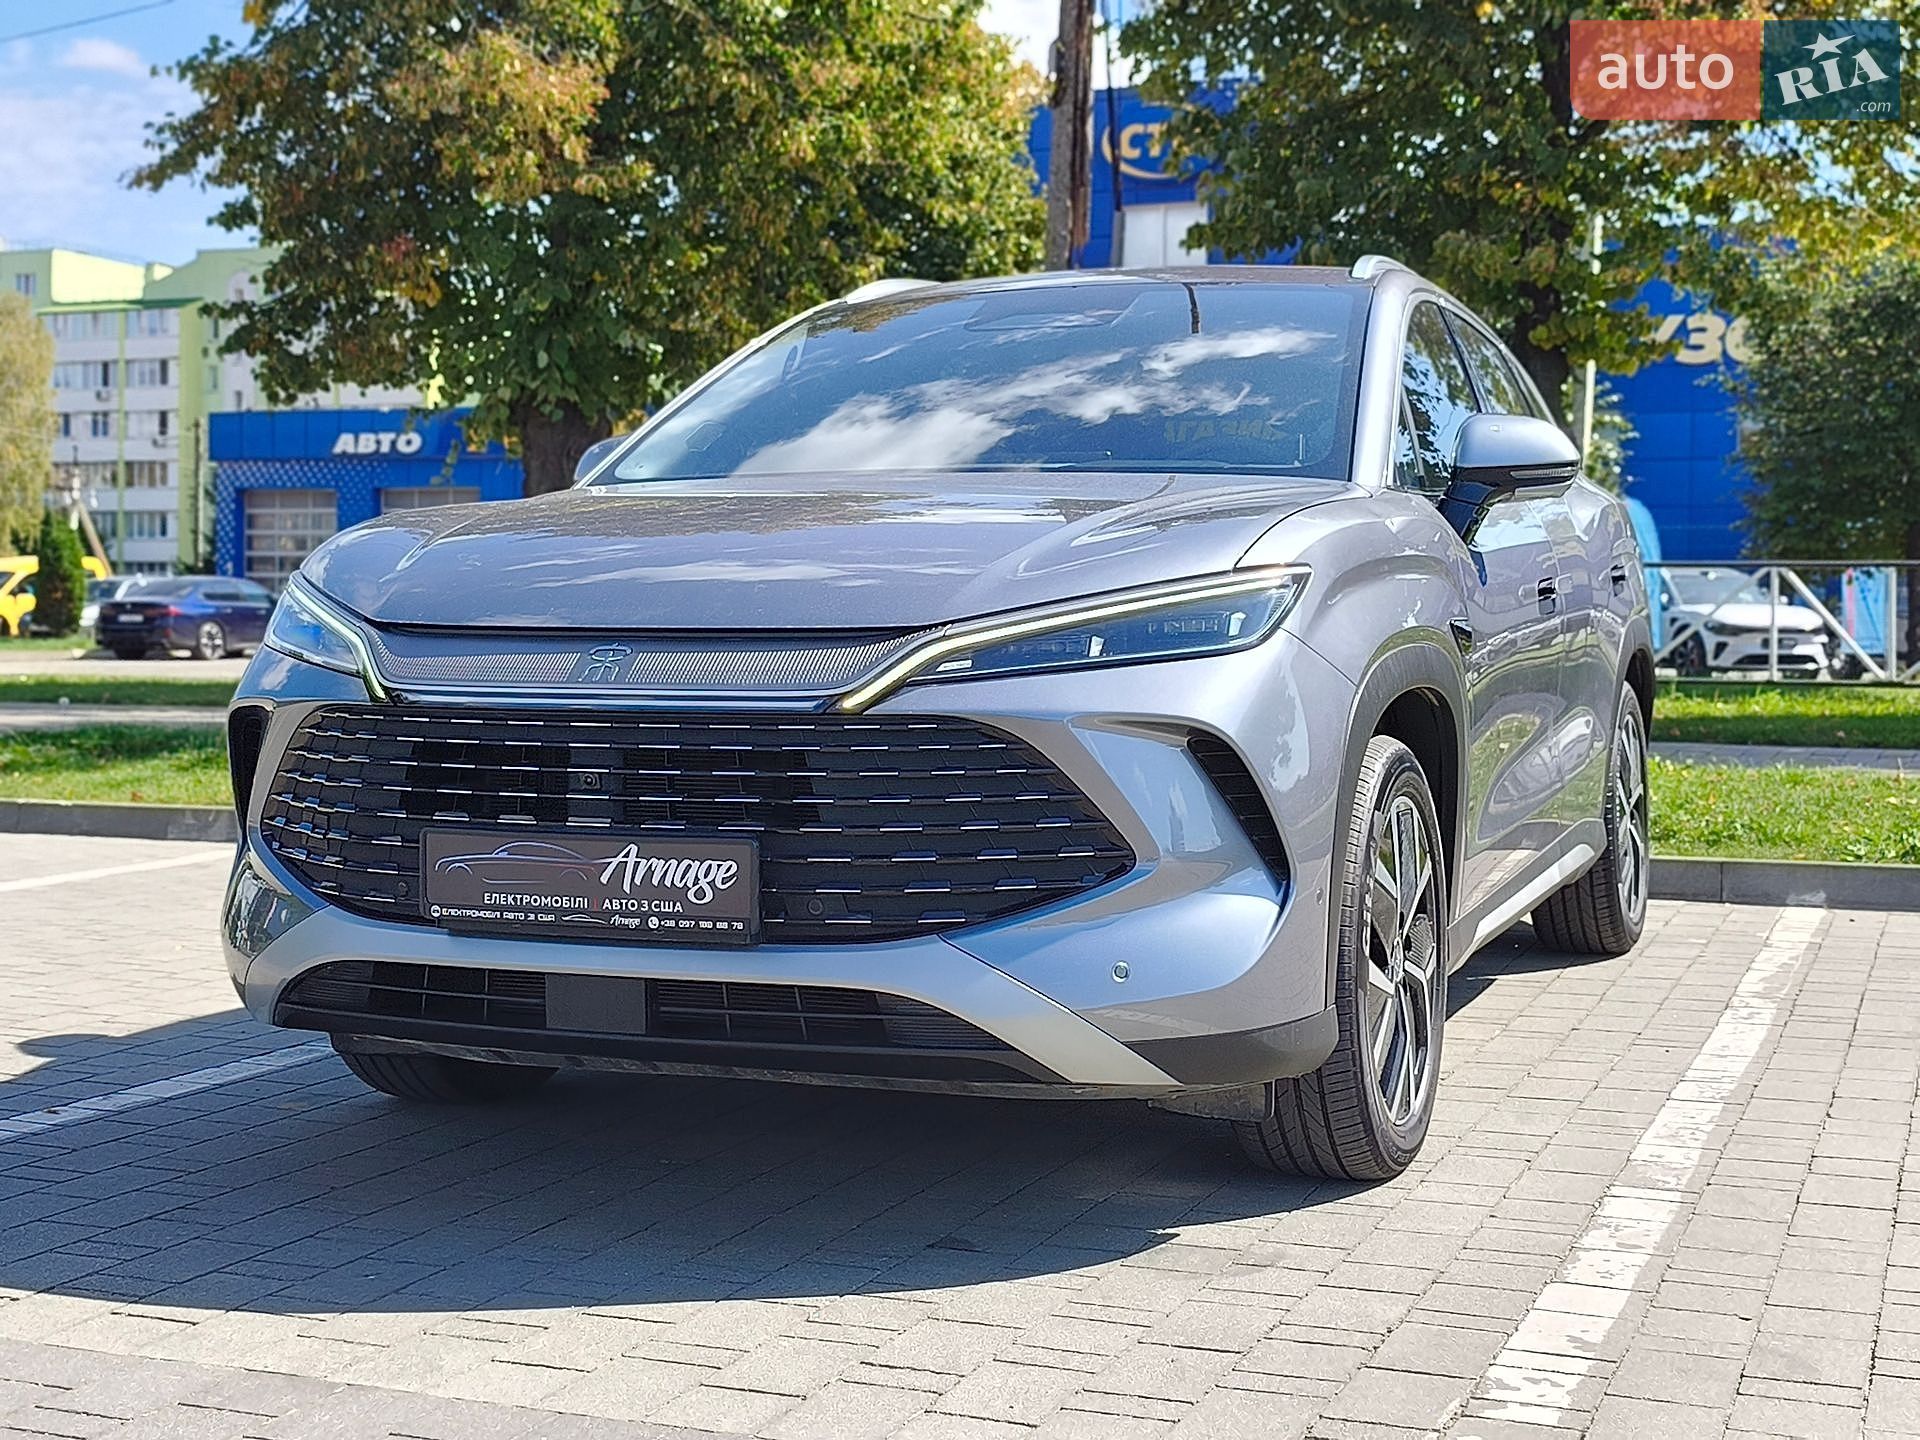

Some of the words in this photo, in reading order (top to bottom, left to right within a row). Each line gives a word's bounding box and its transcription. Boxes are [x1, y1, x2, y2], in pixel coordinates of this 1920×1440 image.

[333, 431, 423, 454] АВТО
[600, 843, 739, 904] Arnage
[484, 892, 589, 909] ЕЛЕКТРОМОБІЛІ
[602, 898, 638, 911] АВТО
[641, 900, 649, 911] З
[651, 900, 684, 913] США
